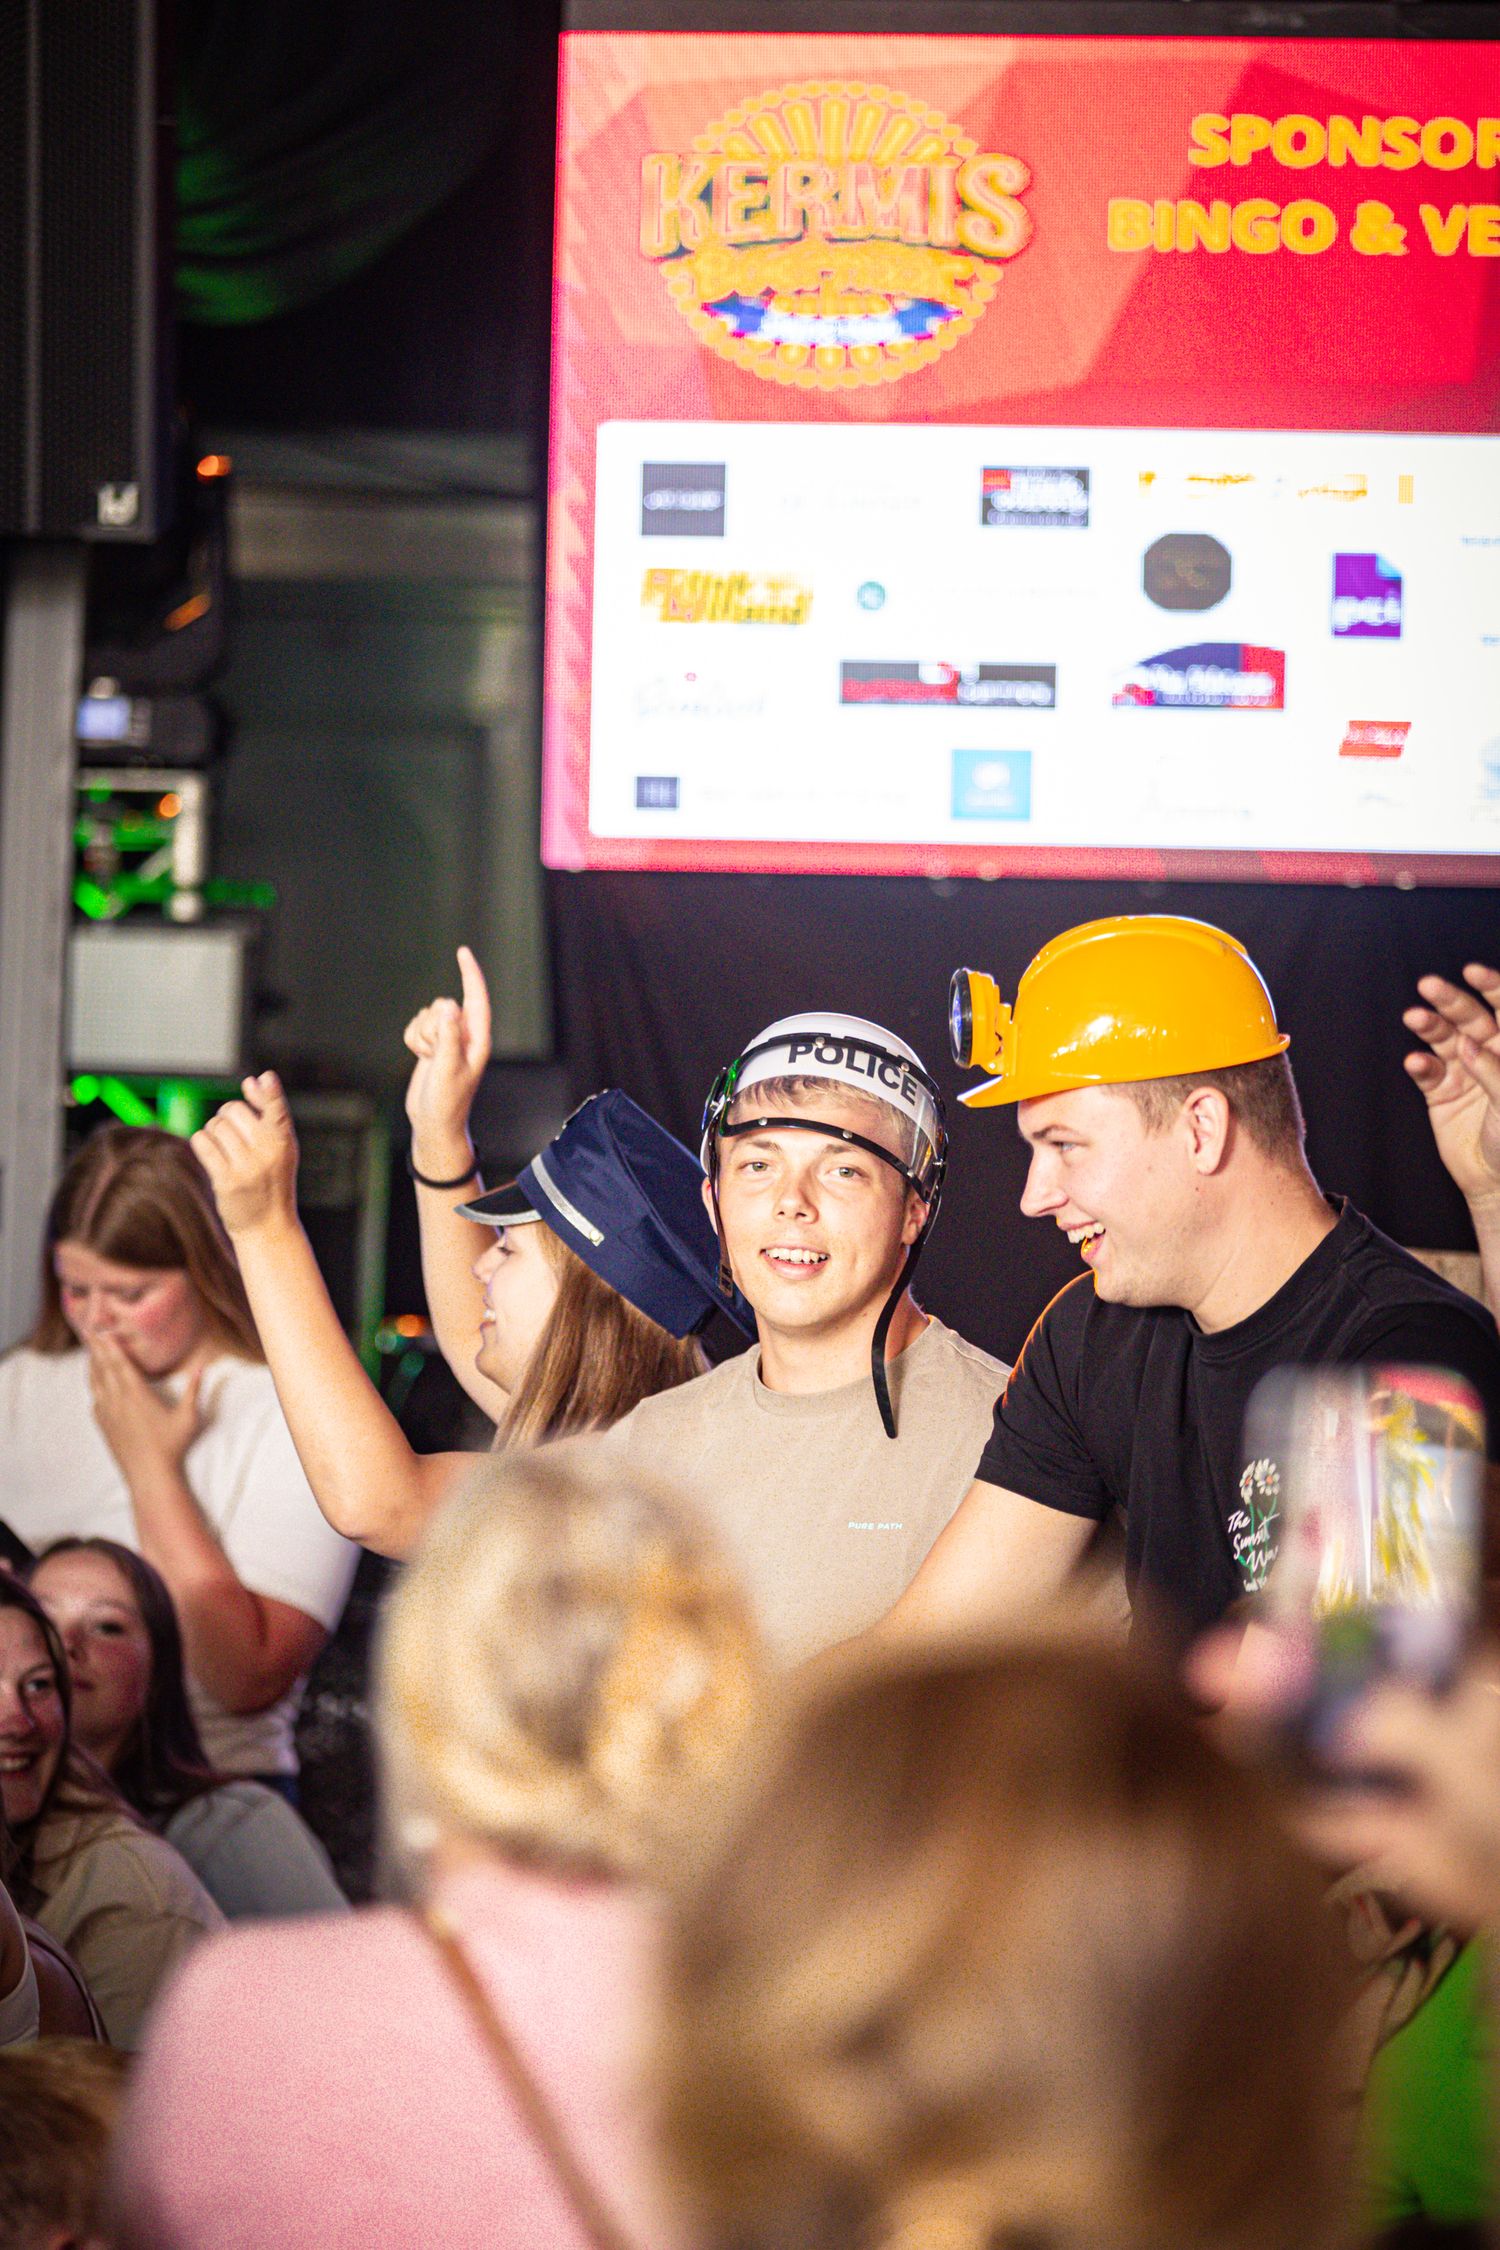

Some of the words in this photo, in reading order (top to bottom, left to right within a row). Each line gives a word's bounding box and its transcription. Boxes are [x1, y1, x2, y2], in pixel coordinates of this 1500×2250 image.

[639, 151, 1034, 260] KERMIS
[1107, 198, 1338, 254] BINGO
[1351, 200, 1410, 256] &
[789, 1045, 918, 1105] POLICE
[848, 1522, 874, 1530] PURE
[1228, 1510, 1251, 1533] The
[1232, 1513, 1281, 1560] Sunset
